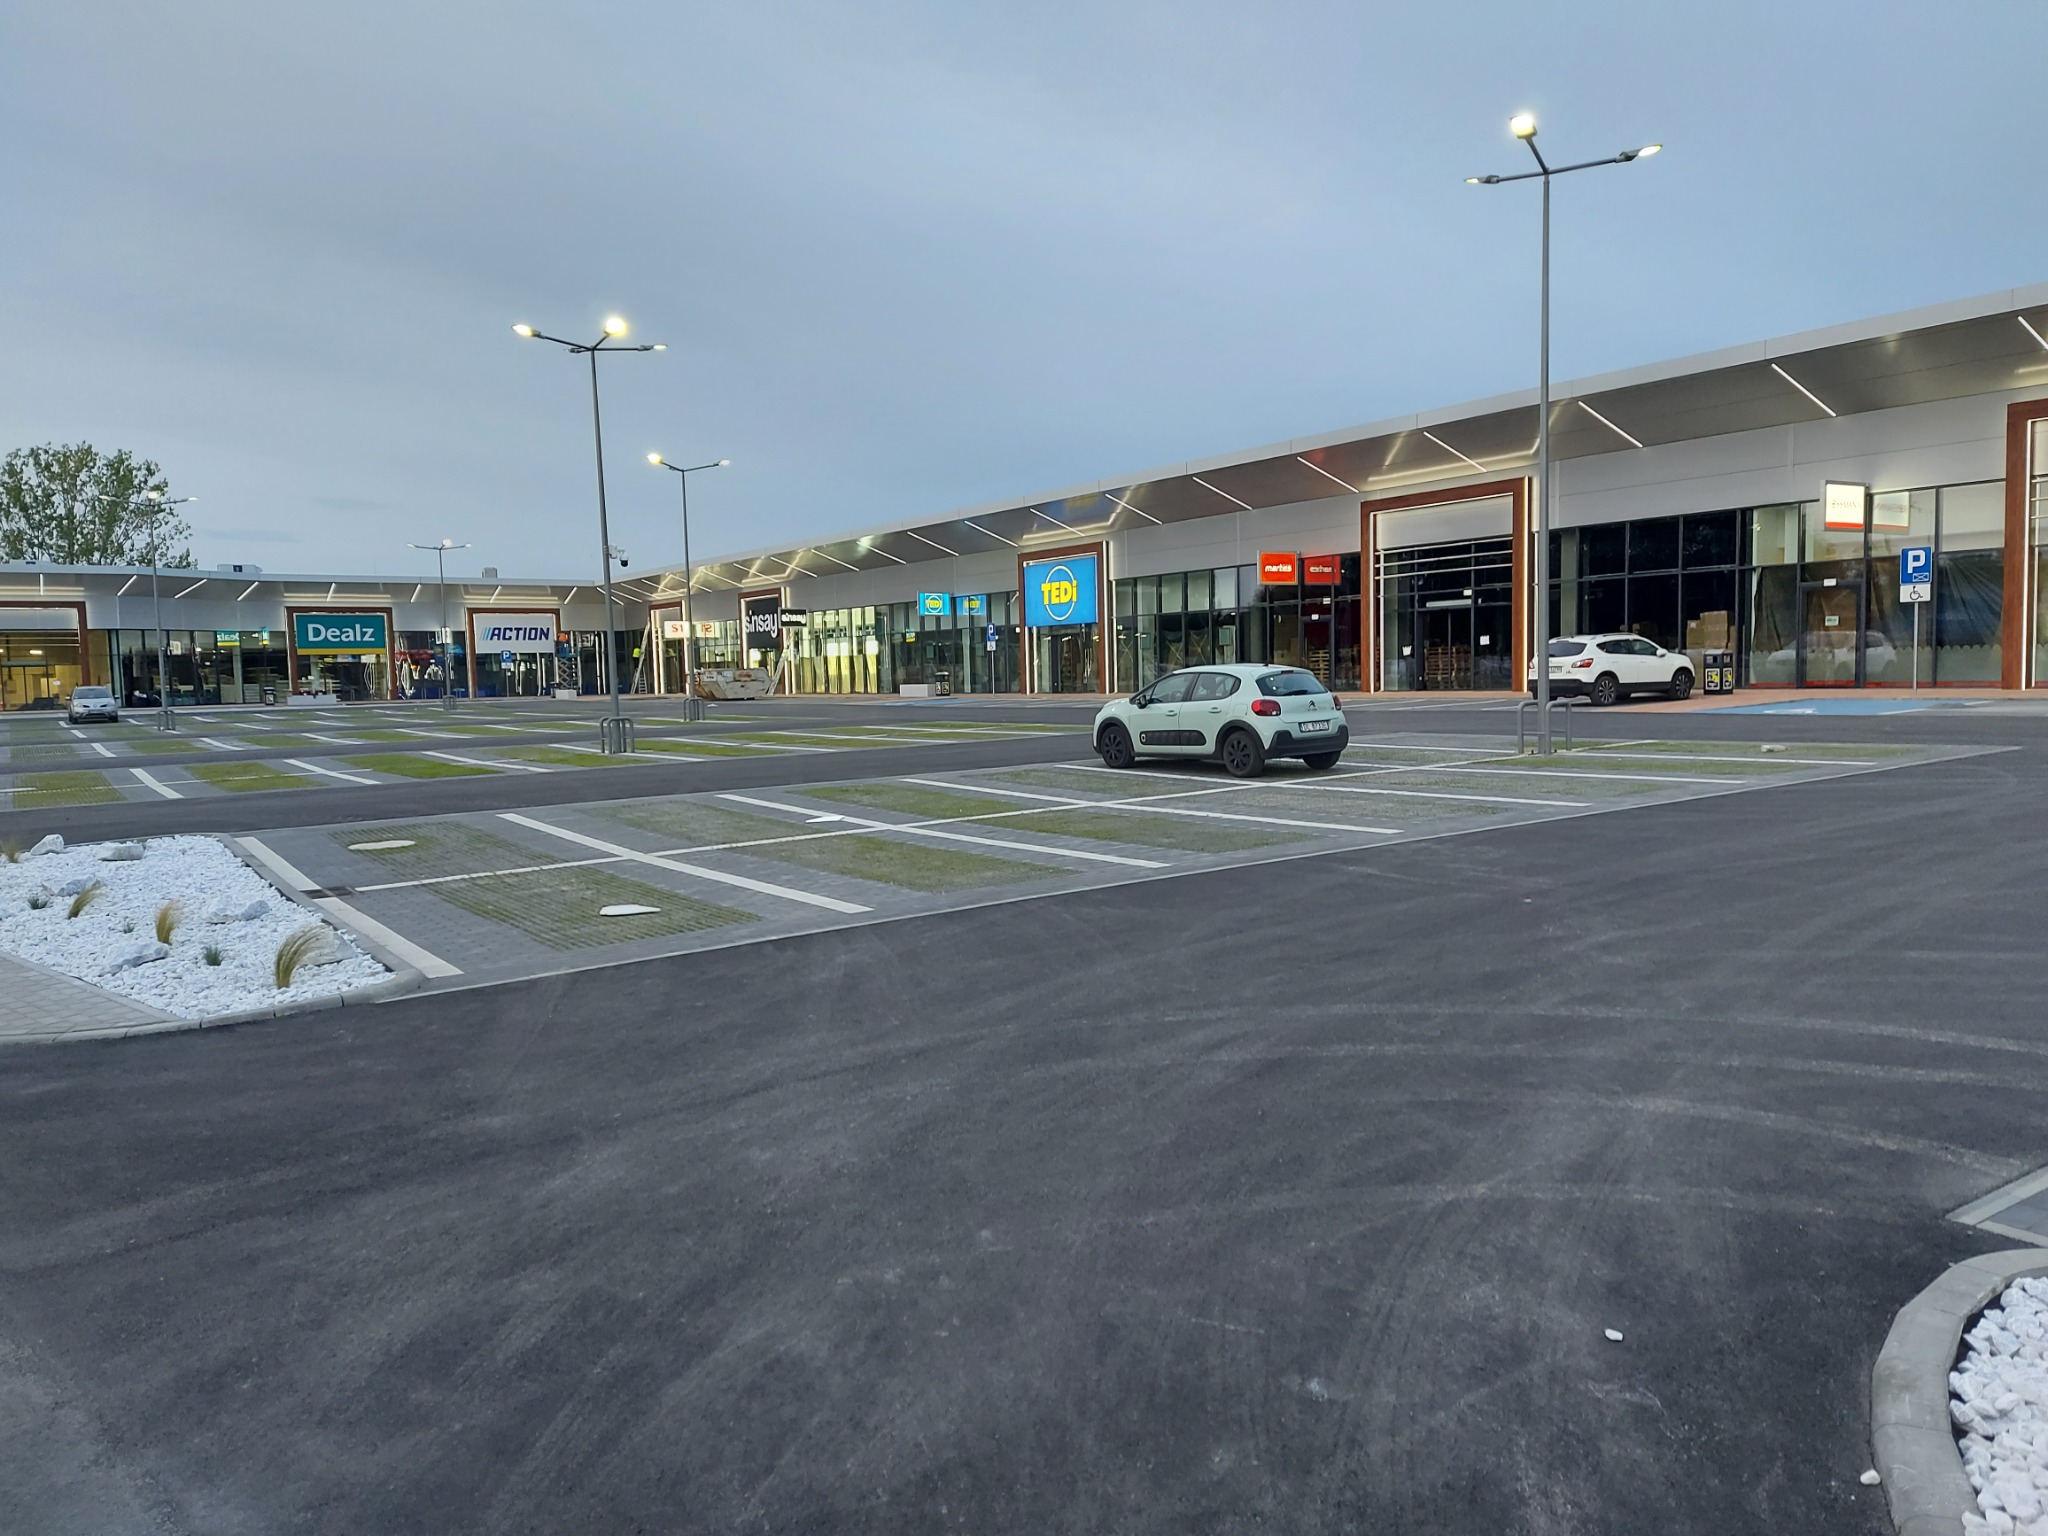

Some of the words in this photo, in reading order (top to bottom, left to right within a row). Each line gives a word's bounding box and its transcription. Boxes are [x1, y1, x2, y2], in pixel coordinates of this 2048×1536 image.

[1907, 550, 1926, 574] P
[1041, 579, 1078, 605] TEDi
[307, 623, 375, 642] Dealz
[489, 626, 550, 641] ACTION
[745, 609, 778, 639] sinsay
[503, 651, 510, 660] P
